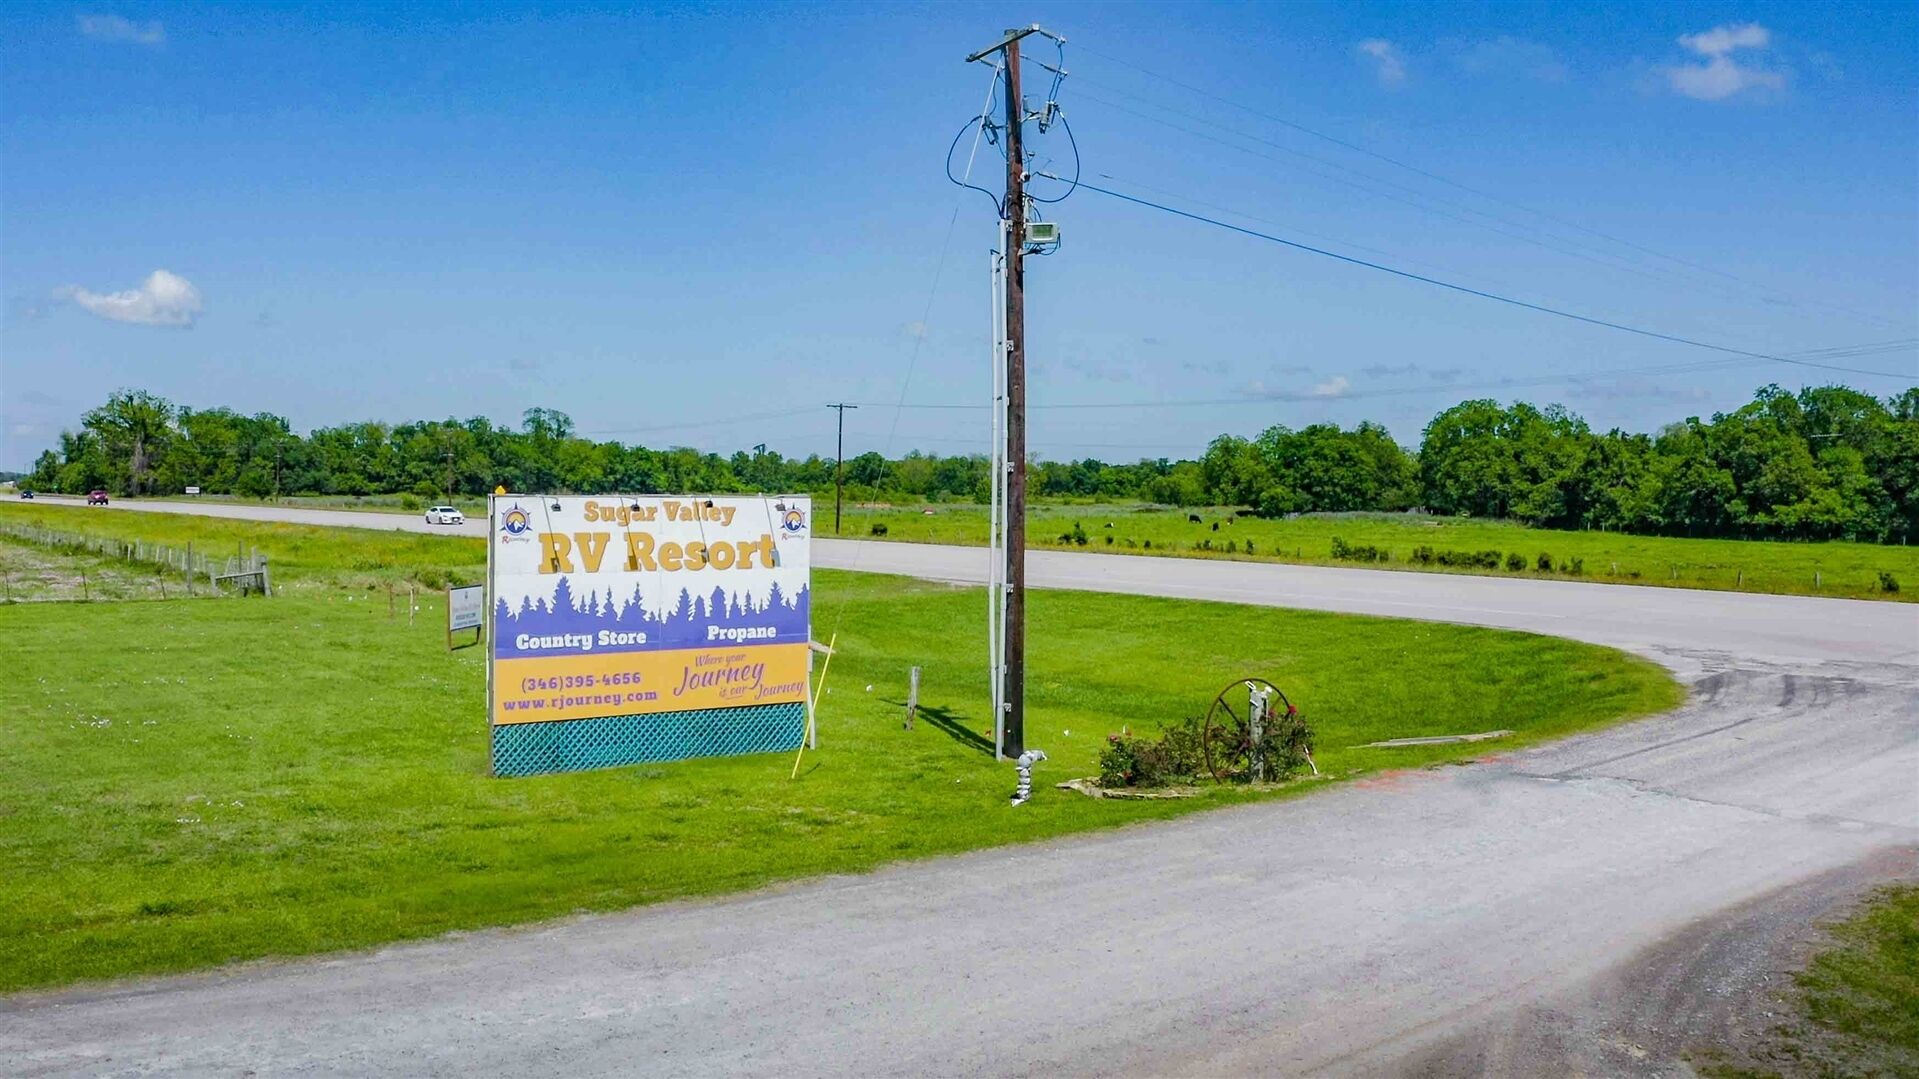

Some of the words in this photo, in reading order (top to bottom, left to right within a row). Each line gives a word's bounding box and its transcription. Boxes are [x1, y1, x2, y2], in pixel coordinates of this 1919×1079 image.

[584, 501, 657, 526] Sugar
[663, 501, 736, 526] Valley
[538, 532, 610, 574] RV
[623, 532, 776, 572] Resort
[516, 633, 593, 650] Country
[598, 630, 647, 646] Store
[707, 625, 777, 642] Propane
[695, 654, 723, 667] Where
[521, 672, 641, 693] (346)395-4656
[673, 663, 765, 696] Journey
[503, 690, 657, 711] www.rjourney.com
[754, 681, 804, 700] Journey
